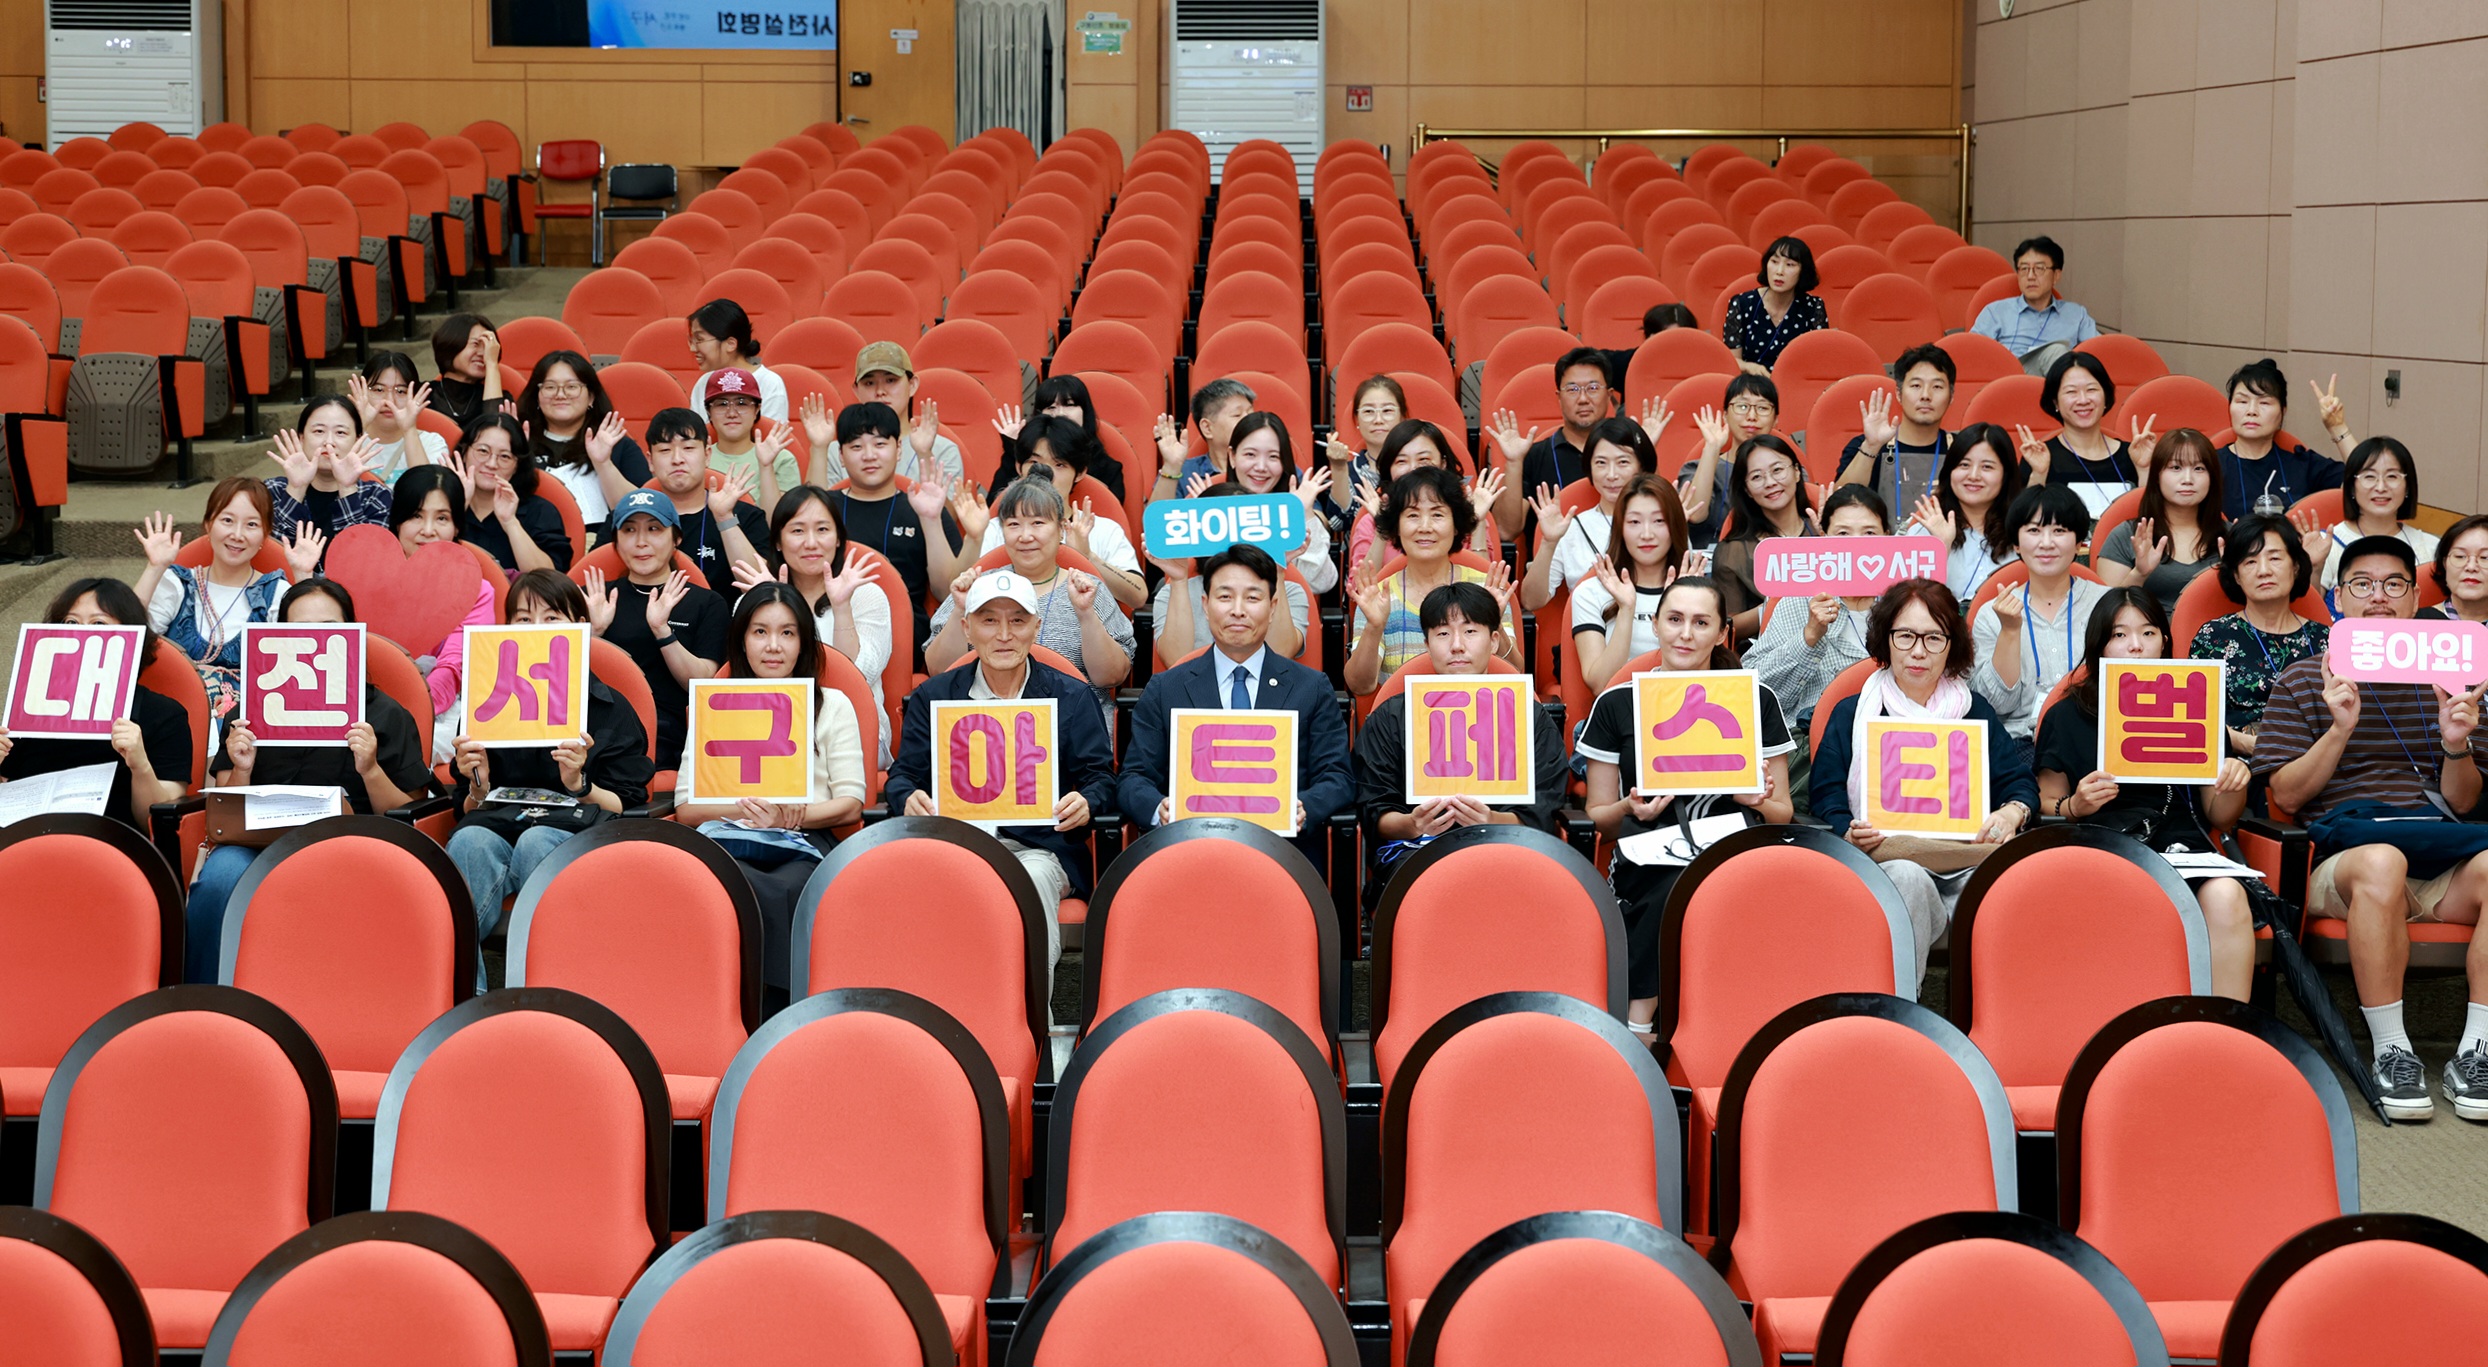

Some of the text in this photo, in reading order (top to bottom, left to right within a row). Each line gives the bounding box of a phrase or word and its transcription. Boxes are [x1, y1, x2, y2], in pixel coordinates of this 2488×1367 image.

[1163, 504, 1291, 546] 화이팅!
[1765, 550, 1937, 583] 사랑해 서구
[24, 634, 126, 721] 대
[256, 634, 350, 727] 전
[474, 635, 570, 726] 서
[2350, 630, 2473, 672] 좋아요!
[704, 692, 797, 784] 구
[950, 711, 1047, 805] 아
[1423, 687, 1517, 781] 페
[1652, 683, 1747, 773] 스
[2119, 672, 2208, 764] 벌
[1185, 723, 1281, 814] 트
[1880, 730, 1970, 820] 티
